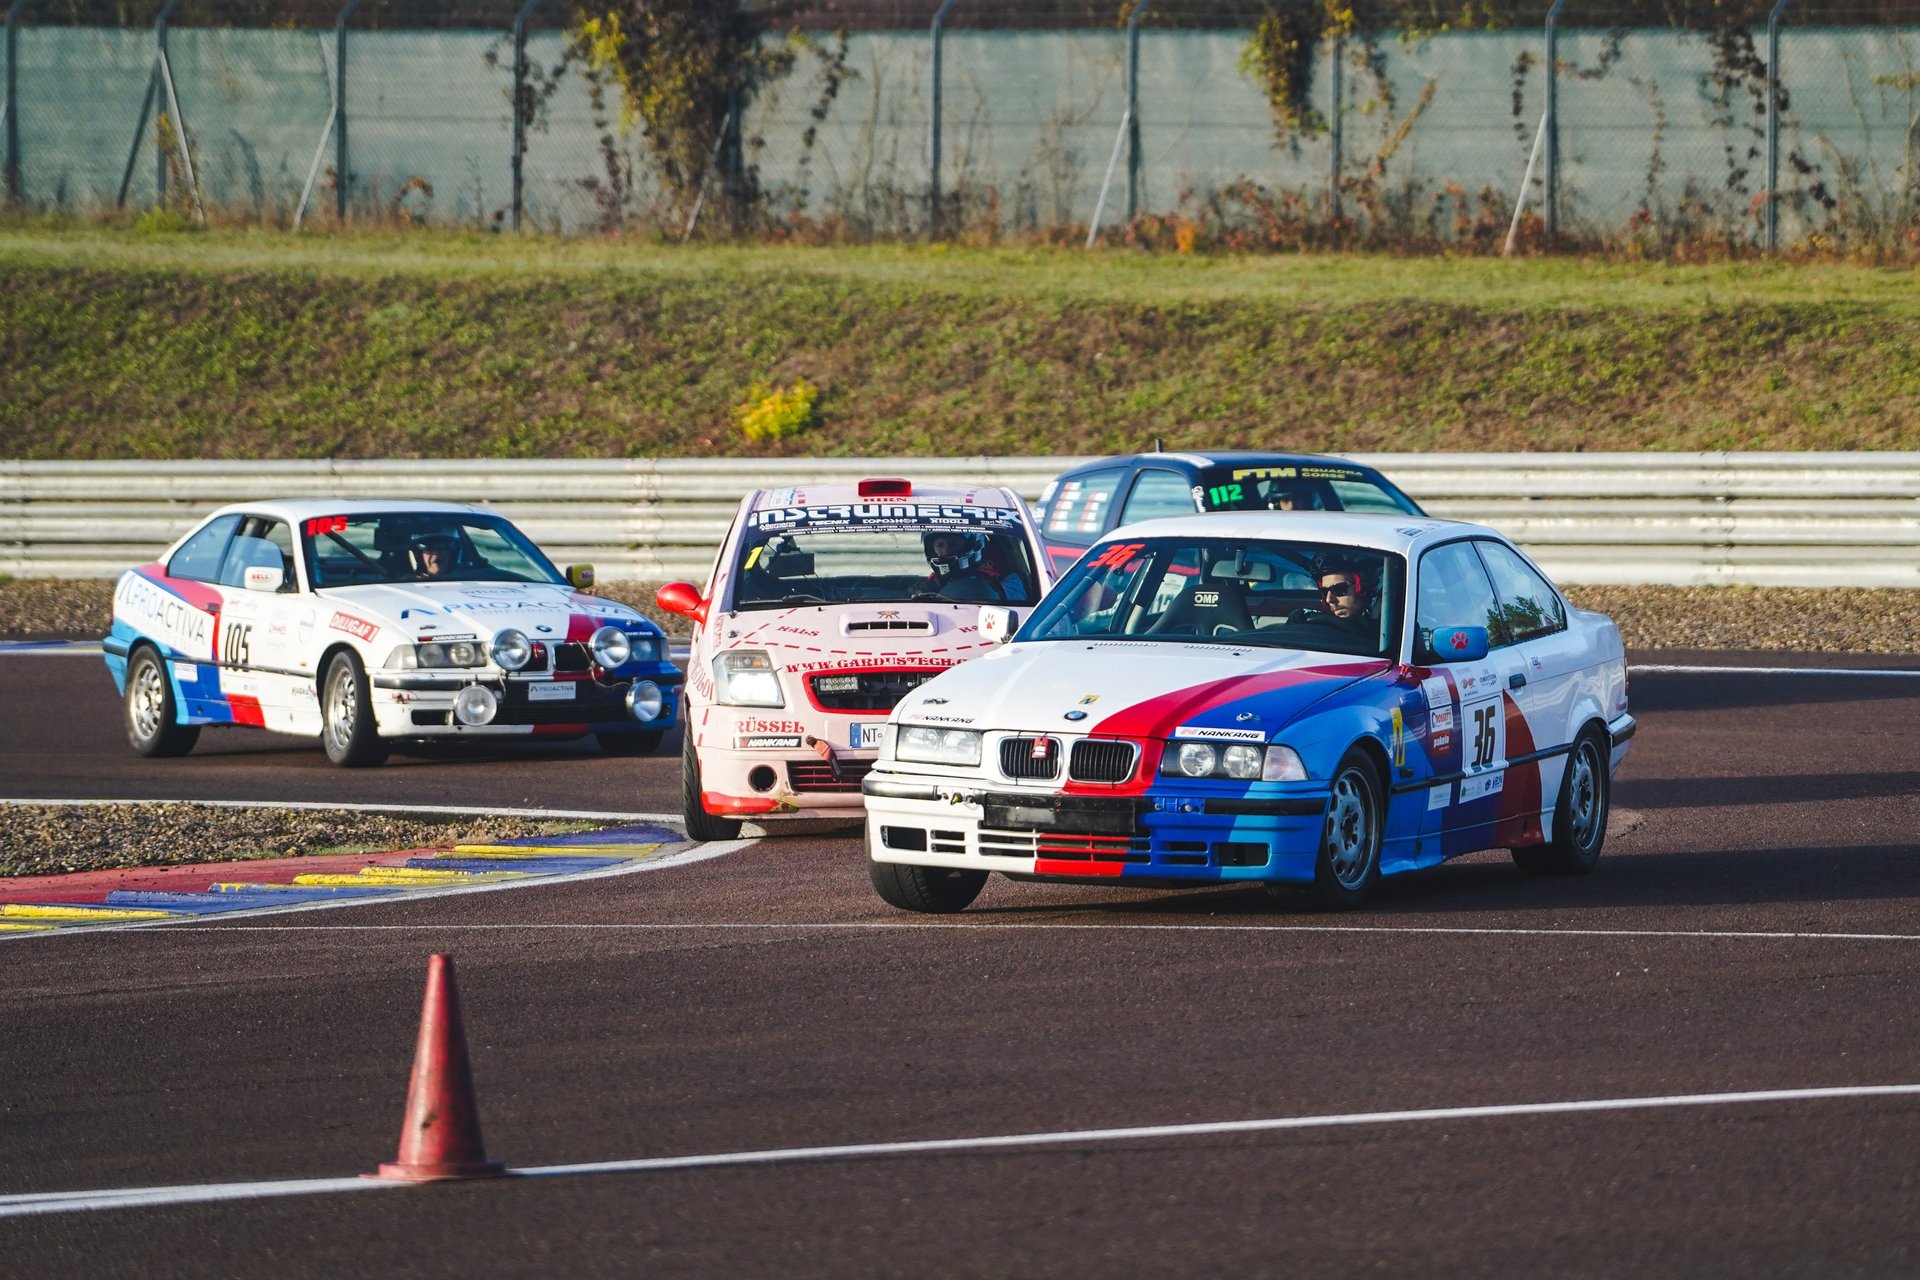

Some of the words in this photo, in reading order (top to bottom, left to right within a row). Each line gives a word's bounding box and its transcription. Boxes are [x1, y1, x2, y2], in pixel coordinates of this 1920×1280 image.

[1232, 467, 1296, 481] FTM
[1301, 467, 1364, 477] SQUADRA
[1209, 484, 1244, 507] 112
[307, 517, 348, 537] 105
[744, 546, 764, 571] 1
[1087, 543, 1146, 570] 36
[1194, 594, 1220, 604] OMP
[443, 601, 635, 615] PROACTIVA
[776, 625, 821, 637] HALS
[225, 622, 252, 673] 105
[734, 716, 805, 734] RÜSSEL
[923, 716, 975, 724] NANKANG
[1198, 730, 1260, 739] NANKANG
[1471, 705, 1496, 773] 36
[748, 738, 800, 747] NANKANG
